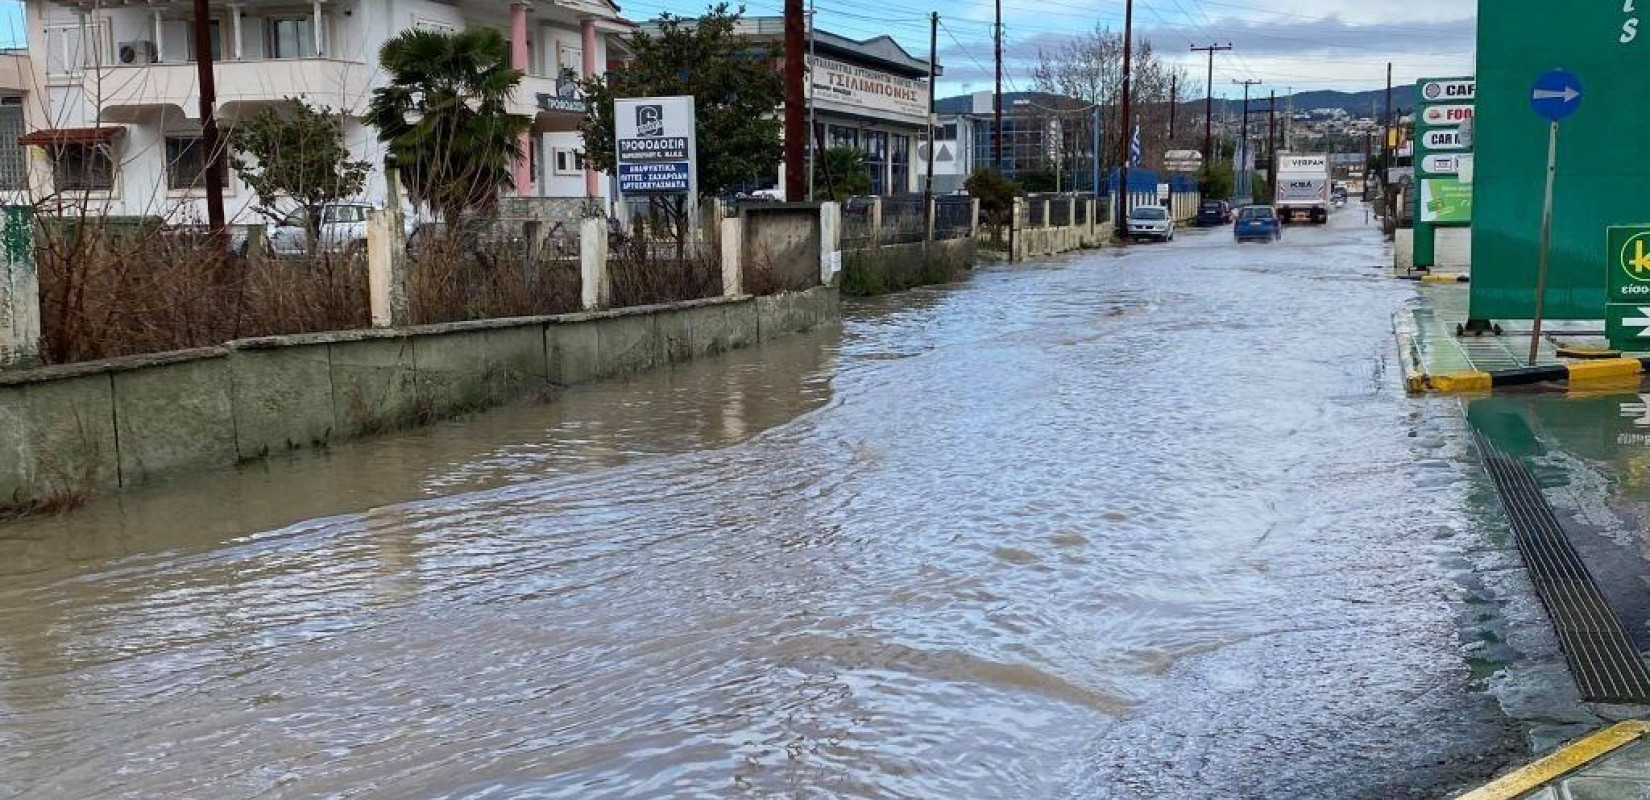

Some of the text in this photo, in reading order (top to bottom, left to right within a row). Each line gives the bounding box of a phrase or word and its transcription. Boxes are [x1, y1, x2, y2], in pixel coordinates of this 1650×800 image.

[827, 72, 918, 102] ΤΣΙΛΙΜΠΟΝΗΣ
[621, 138, 684, 151] ΤΡΟΦΟΔΟΣΙΑ
[1431, 133, 1453, 145] CAR
[629, 164, 676, 173] ΑΝΑΨΥΚΤΙΚΑ
